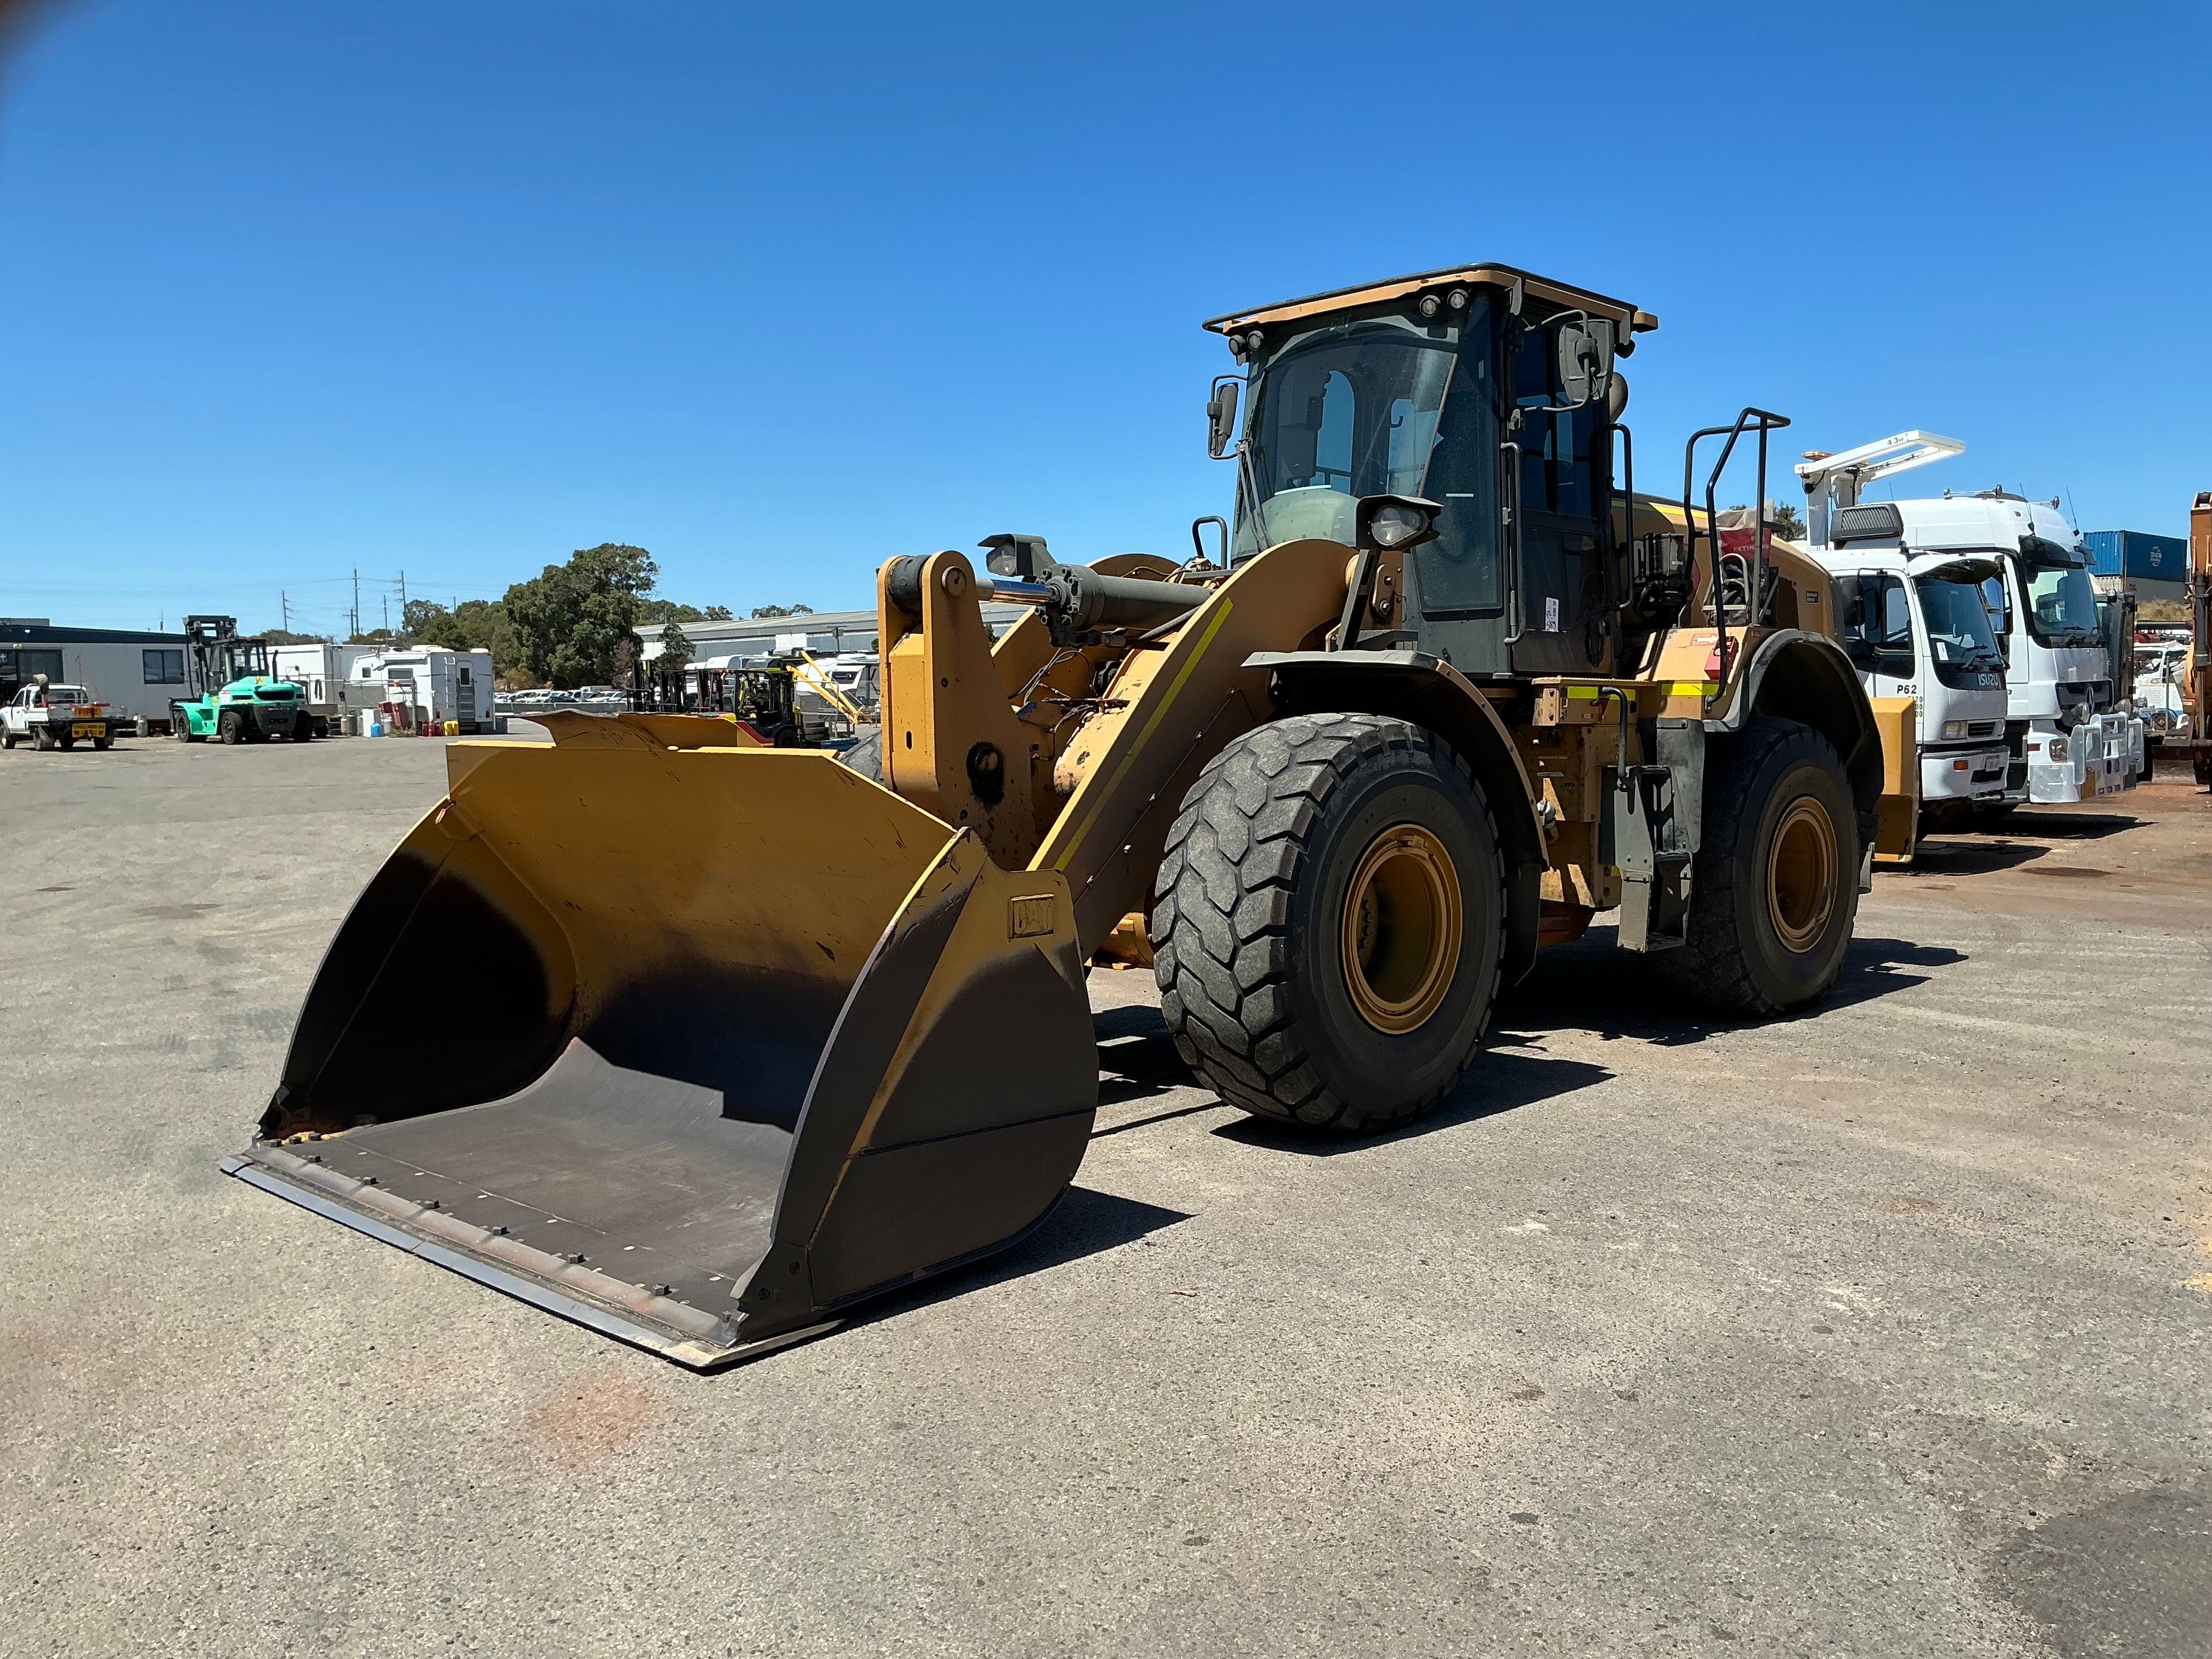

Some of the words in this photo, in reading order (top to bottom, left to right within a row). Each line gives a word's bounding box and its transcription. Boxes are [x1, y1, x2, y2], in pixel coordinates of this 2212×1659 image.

[1977, 673, 2002, 689] ISUZU
[1897, 684, 1917, 695] P62
[1014, 900, 1051, 935] CAT
